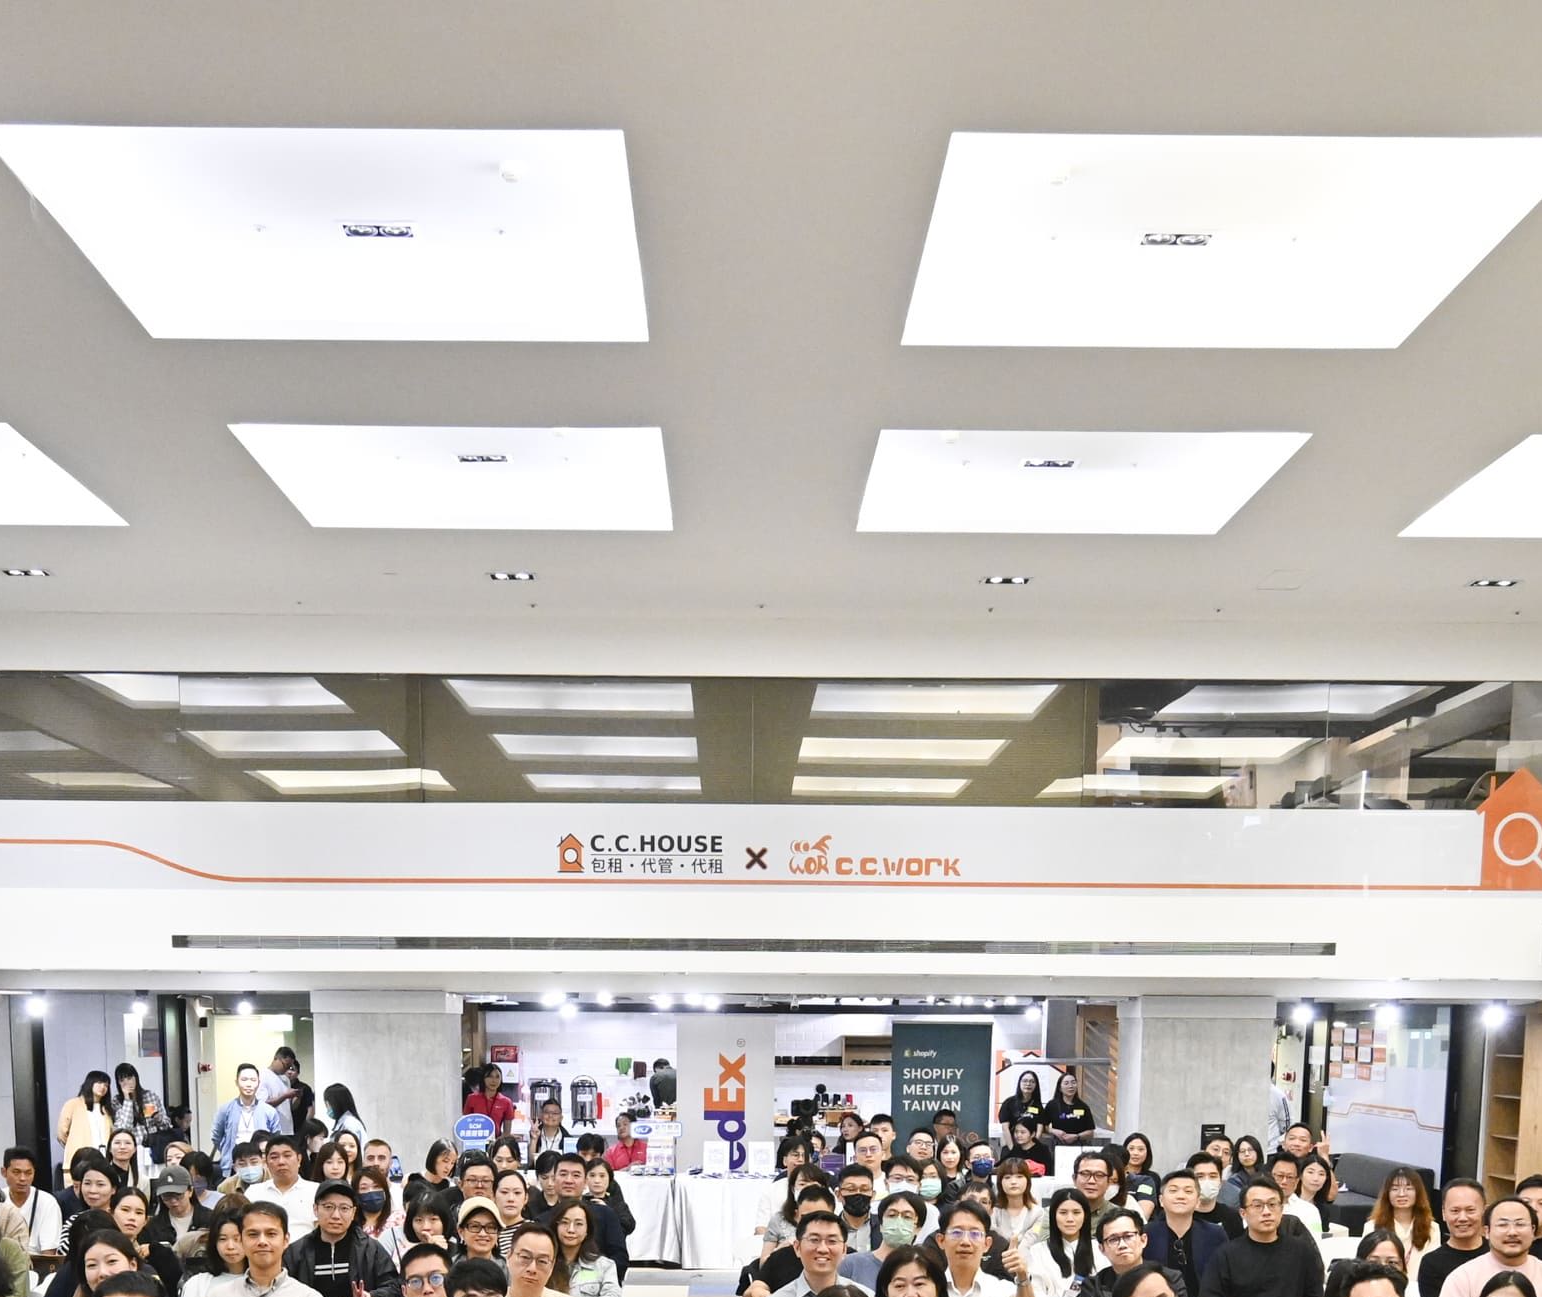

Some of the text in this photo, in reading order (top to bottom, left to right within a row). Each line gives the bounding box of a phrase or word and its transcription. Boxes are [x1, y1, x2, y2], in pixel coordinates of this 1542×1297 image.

[590, 834, 724, 853] C.C.HOUSE
[903, 1068, 964, 1080] SHOPIFY
[903, 1084, 959, 1096] MEETUP
[704, 1052, 746, 1169] edEx
[903, 1100, 961, 1112] TAIWAN
